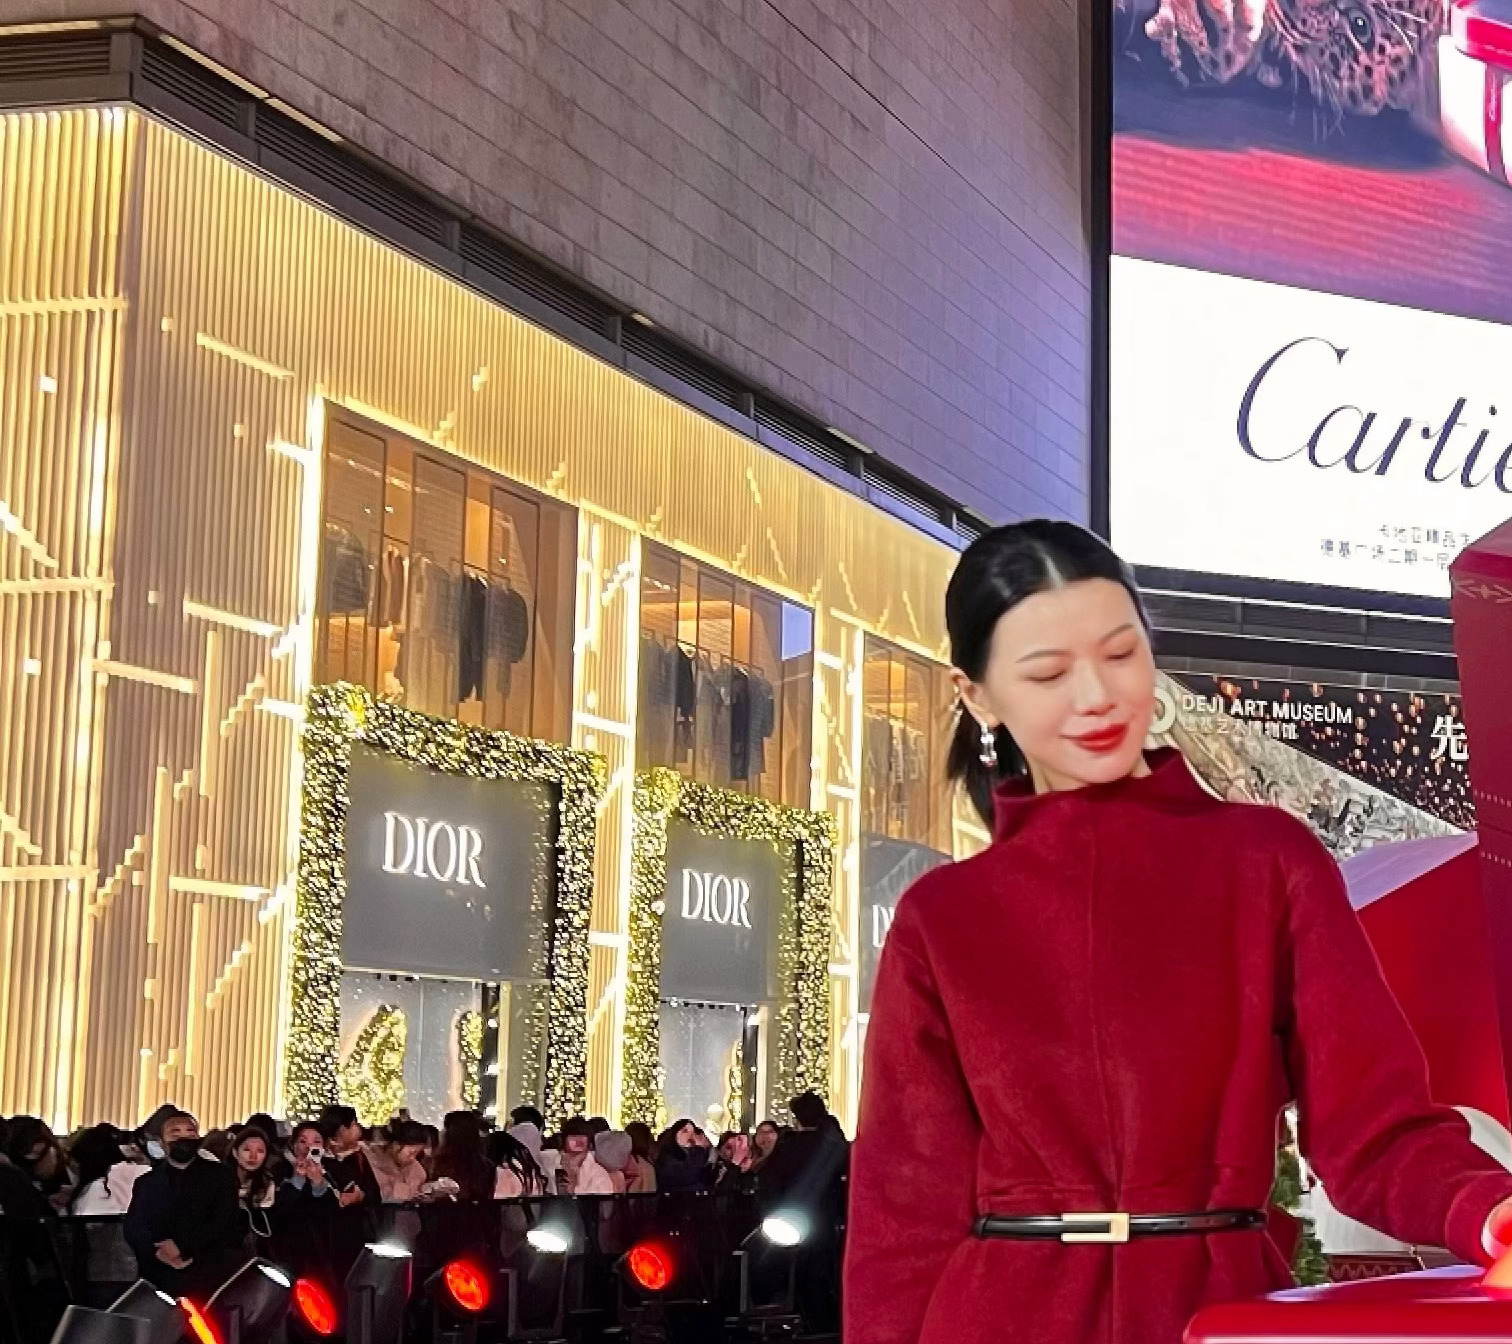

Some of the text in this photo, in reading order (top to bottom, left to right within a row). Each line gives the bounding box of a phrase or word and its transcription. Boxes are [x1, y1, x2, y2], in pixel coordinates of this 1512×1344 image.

[1182, 694, 1353, 724] DEJI ART MUSEUM
[381, 810, 487, 888] DIOR
[681, 868, 753, 930] DIOR
